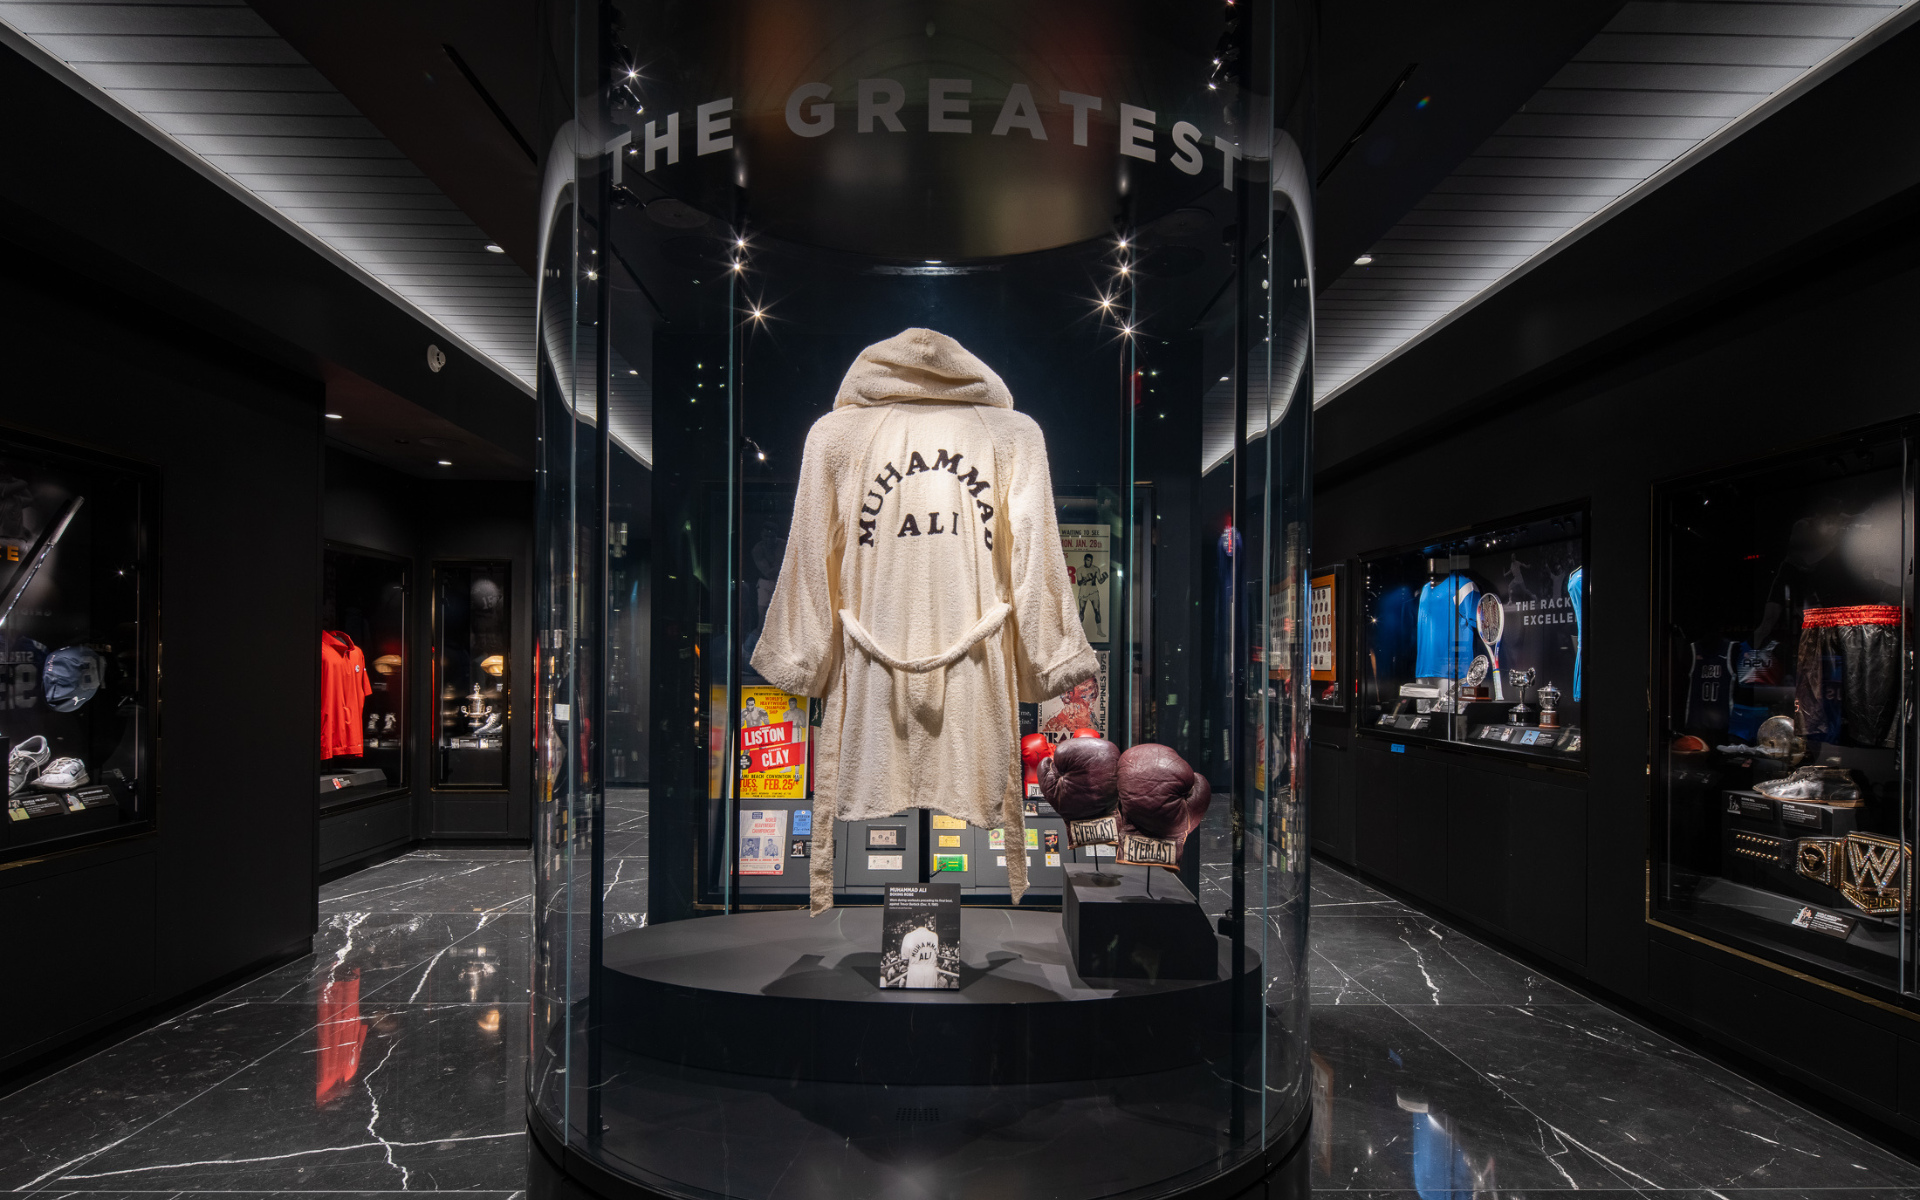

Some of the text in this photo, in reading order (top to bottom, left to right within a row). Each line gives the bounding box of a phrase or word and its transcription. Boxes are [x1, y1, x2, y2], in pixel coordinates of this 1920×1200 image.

[604, 77, 1243, 192] THE GREATEST
[859, 448, 994, 551] MUHAMMAD
[897, 511, 959, 538] ALI
[1075, 539, 1088, 548] JAN.
[1089, 539, 1103, 549] 28th
[1515, 597, 1572, 612] THE RACK
[744, 726, 785, 746] LISTON
[761, 748, 789, 767] CLAY
[763, 778, 781, 791] FEB.
[1073, 818, 1116, 845] EVERLAST
[1127, 839, 1174, 865] EVERLAST
[911, 941, 938, 958] MUHAMM
[919, 951, 932, 961] ALI
